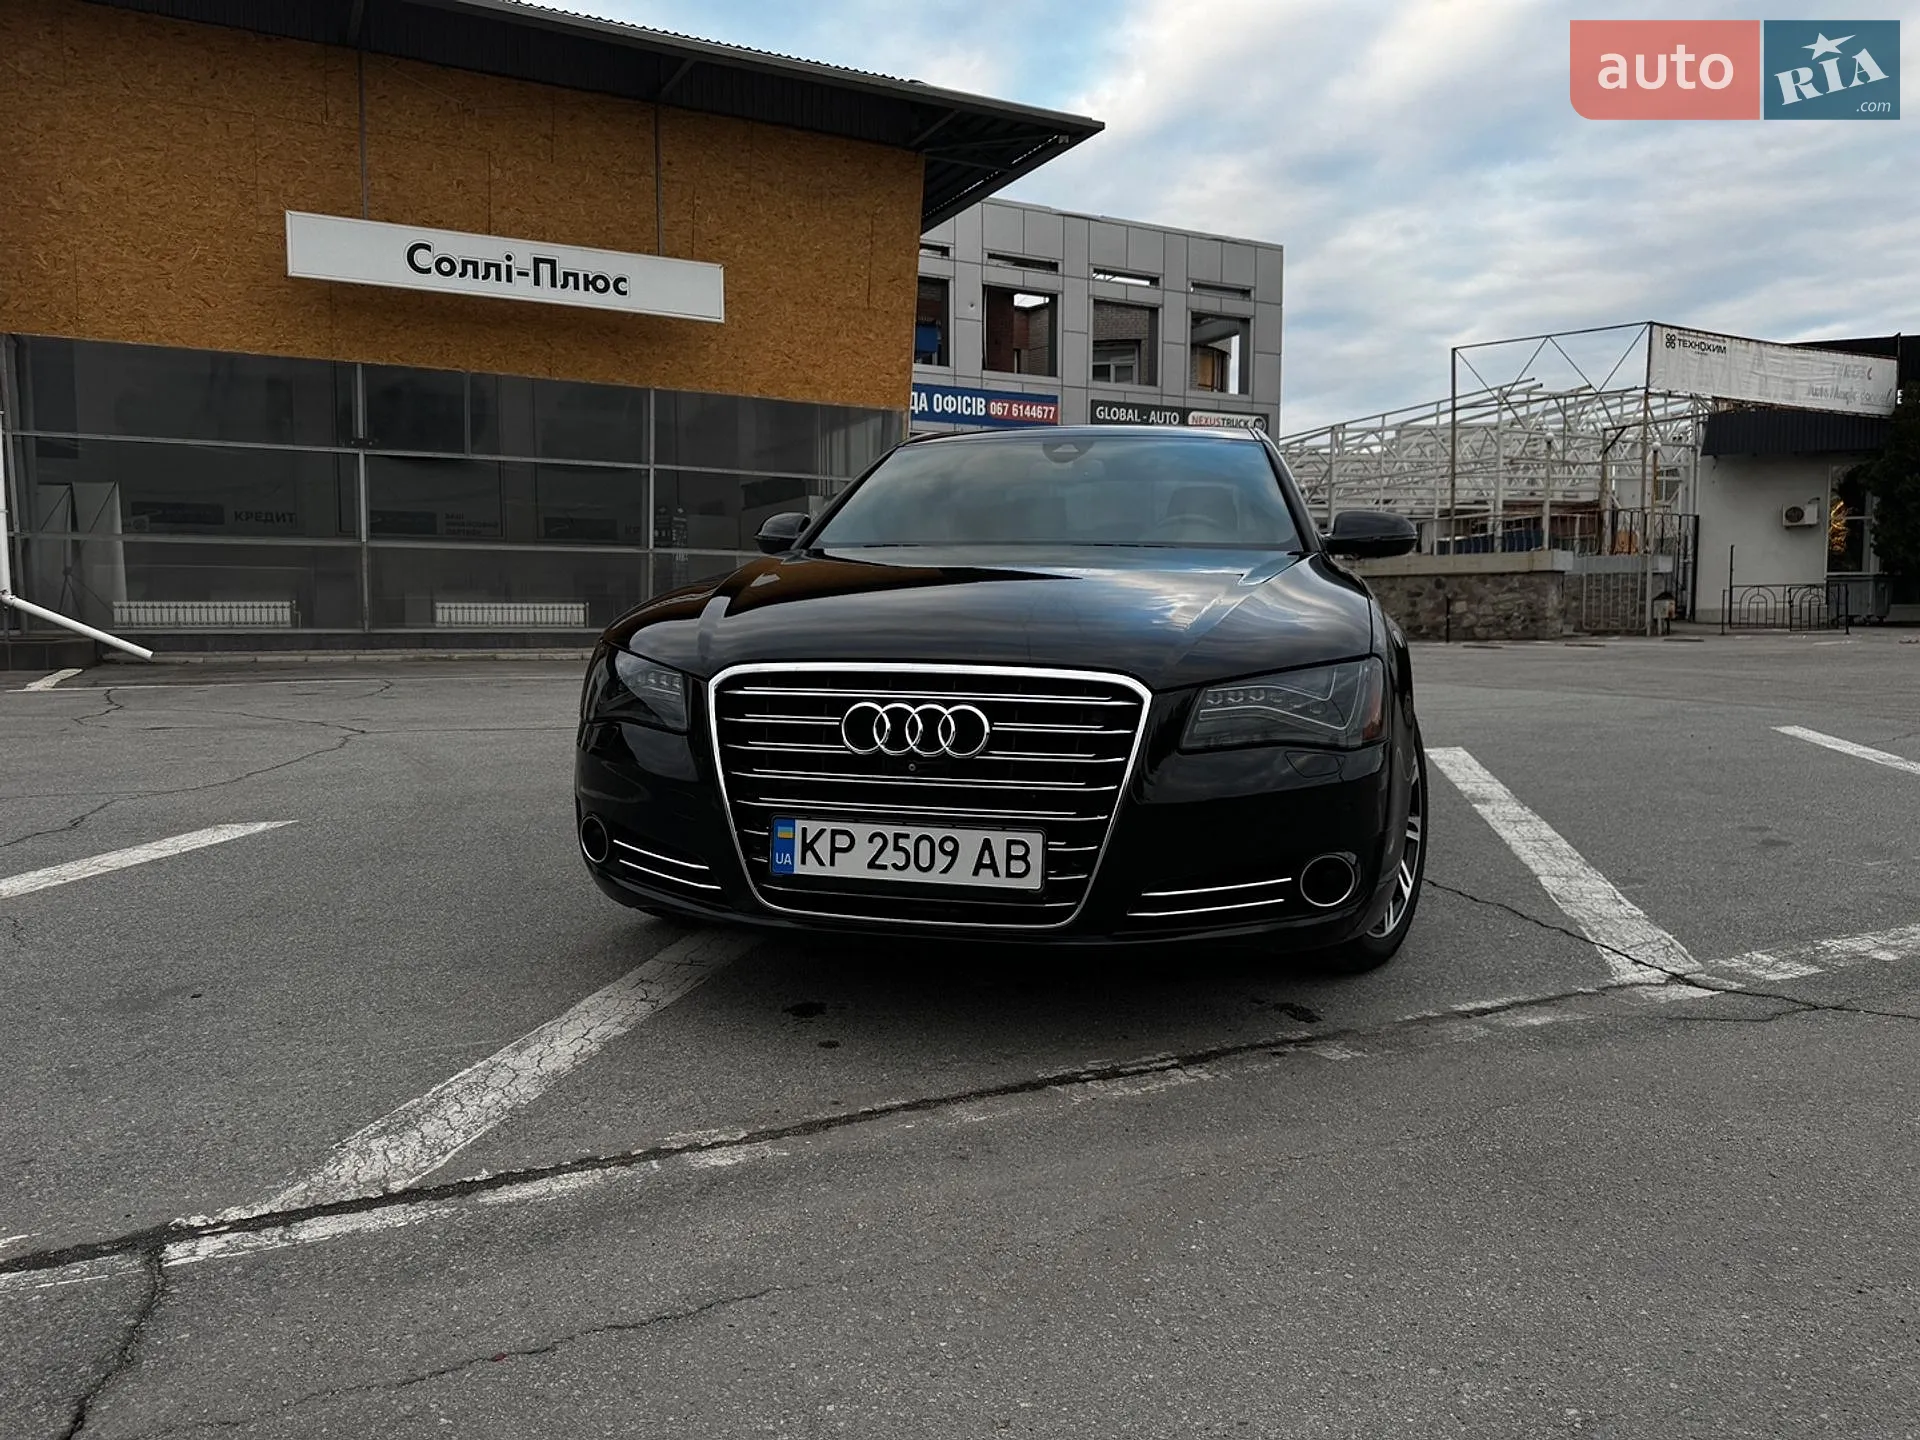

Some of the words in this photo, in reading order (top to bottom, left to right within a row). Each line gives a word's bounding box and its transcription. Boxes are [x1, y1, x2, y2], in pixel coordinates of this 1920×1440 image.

[406, 242, 629, 296] Соллі-Плюс
[1678, 338, 1727, 354] ТЕХНОХИМ
[933, 393, 986, 416] ОФІСІВ
[990, 401, 1009, 416] 067
[1011, 403, 1055, 419] 6144677
[1096, 406, 1141, 422] GLOBAL
[1150, 410, 1180, 425] AUTO
[234, 510, 296, 524] КРЕДИТ
[775, 851, 792, 865] UA
[800, 827, 856, 867] KP
[866, 831, 960, 874] 2509
[972, 837, 1031, 879] AB
